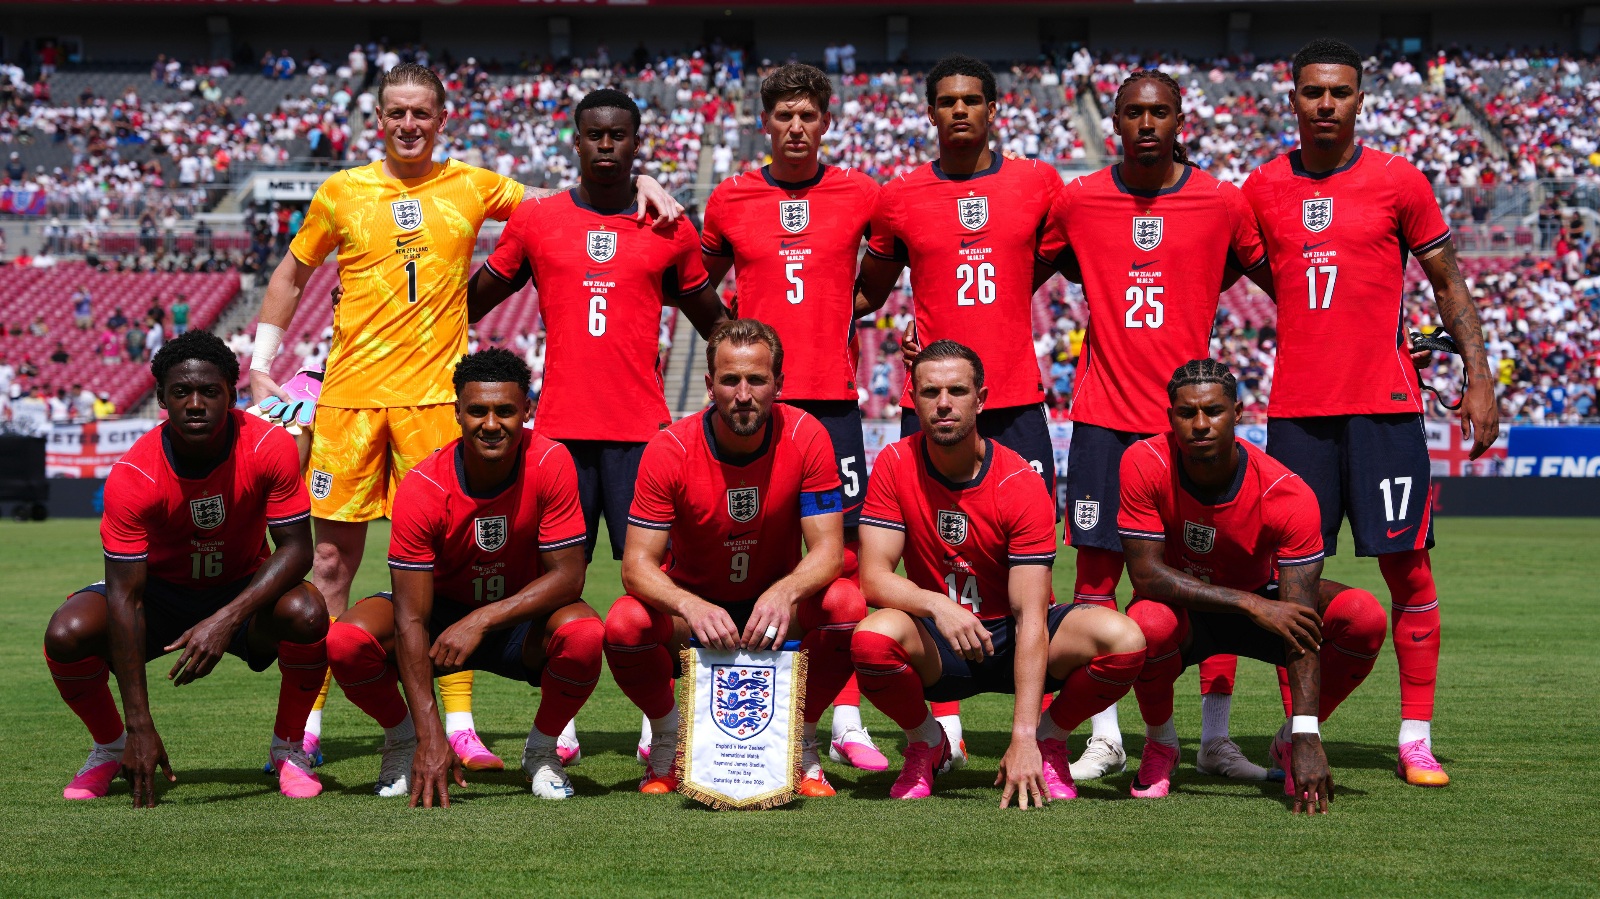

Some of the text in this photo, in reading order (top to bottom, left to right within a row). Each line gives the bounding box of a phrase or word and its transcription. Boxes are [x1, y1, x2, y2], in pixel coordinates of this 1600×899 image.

[404, 260, 417, 304] 1
[785, 263, 804, 304] 5
[956, 262, 996, 306] 26
[1305, 265, 1338, 310] 17
[588, 295, 607, 337] 6
[1125, 286, 1164, 329] 25
[840, 455, 860, 498] 5
[1379, 476, 1412, 522] 17
[189, 551, 223, 580] 16
[729, 552, 750, 583] 9
[471, 574, 505, 602] 19
[944, 572, 983, 614] 14
